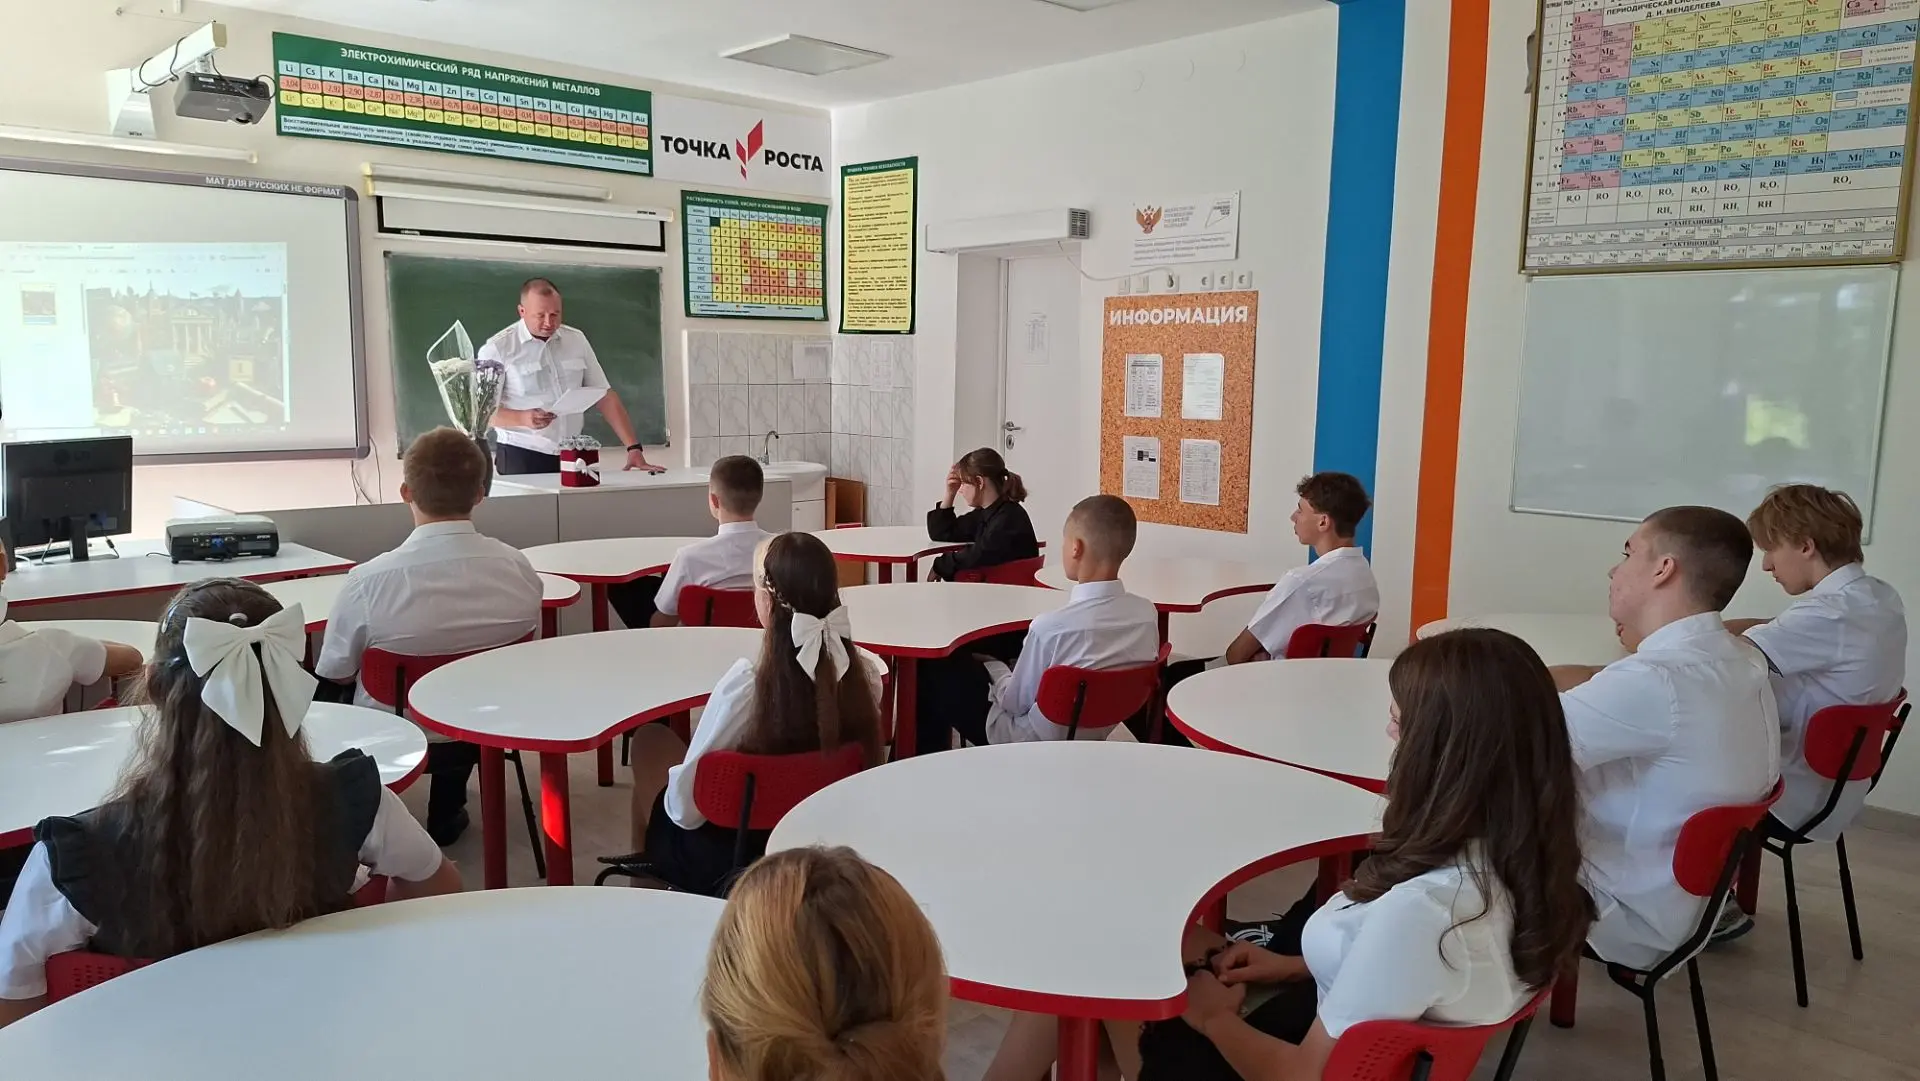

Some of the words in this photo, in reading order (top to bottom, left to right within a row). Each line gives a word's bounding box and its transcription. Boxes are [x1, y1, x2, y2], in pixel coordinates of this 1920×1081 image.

[1606, 0, 1673, 15] ПЕРИОДИЧЕСКАЯ
[1666, 0, 1721, 15] МЕНДЕЛЕЕВА
[1734, 9, 1742, 17] O
[1601, 48, 1614, 56] Mg
[1632, 43, 1642, 51] Al
[1767, 23, 1778, 32] Cl
[1804, 19, 1816, 27] Ar
[1750, 45, 1763, 54] Cr
[1862, 30, 1877, 39] Co
[1905, 24, 1916, 33] Ni
[340, 48, 458, 74] ЭЛЕКТРОХИМИЧЕСКИЙ
[462, 66, 481, 80] РЯД
[485, 70, 549, 89] НАПРЯЖЕНИЙ
[552, 81, 600, 96] МЕТАЛЛОВ
[1661, 77, 1673, 85] Ge
[1800, 59, 1813, 67] Kr
[286, 64, 294, 73] Li
[306, 67, 316, 76] Cs
[328, 70, 335, 78] K
[347, 73, 359, 82] Ba
[368, 76, 379, 84] Ca
[388, 79, 399, 87] Na
[406, 81, 420, 91] Mg
[429, 84, 437, 92] Al
[446, 86, 457, 95] Zn
[466, 90, 475, 98] Fe
[483, 92, 494, 101] Co
[503, 94, 511, 103] Ni
[520, 97, 529, 105] Sn
[537, 100, 547, 108] Pb
[570, 105, 581, 113] Cu
[587, 107, 598, 117] Ag
[603, 109, 613, 119] Hg
[621, 111, 629, 120] Pt
[635, 114, 645, 123] Au
[1567, 106, 1578, 114] Rb
[1679, 93, 1690, 101] Zr
[1711, 89, 1724, 97] Nb
[1743, 85, 1760, 93] Mo
[1898, 66, 1912, 76] Pd
[1583, 122, 1593, 130] Ag
[1612, 118, 1624, 126] Cd
[1657, 114, 1668, 122] Sn
[1690, 110, 1701, 118] Sb
[1675, 130, 1687, 138] Hf
[1779, 121, 1791, 129] Re
[1815, 117, 1828, 125] Os
[1856, 112, 1867, 121] Ir
[660, 135, 731, 160] ТОЧКА
[764, 149, 824, 172] РОСТА
[1654, 150, 1665, 158] Pb
[1721, 145, 1732, 153] Po
[1673, 168, 1684, 176] Rf
[1704, 165, 1716, 174] Db
[1739, 163, 1751, 171] Sg
[1774, 160, 1786, 168] Bh
[1811, 156, 1824, 165] Hs
[1848, 154, 1862, 162] Mt
[1889, 150, 1901, 159] Ds
[205, 176, 225, 186] МАТ
[227, 178, 247, 188] ДЛЯ
[249, 180, 290, 192] РУССКИХ
[291, 184, 303, 193] НЕ
[304, 185, 341, 196] ФОРМАТ
[1757, 200, 1772, 208] RH
[1110, 306, 1248, 326] ИНФОРМАЦИЯ
